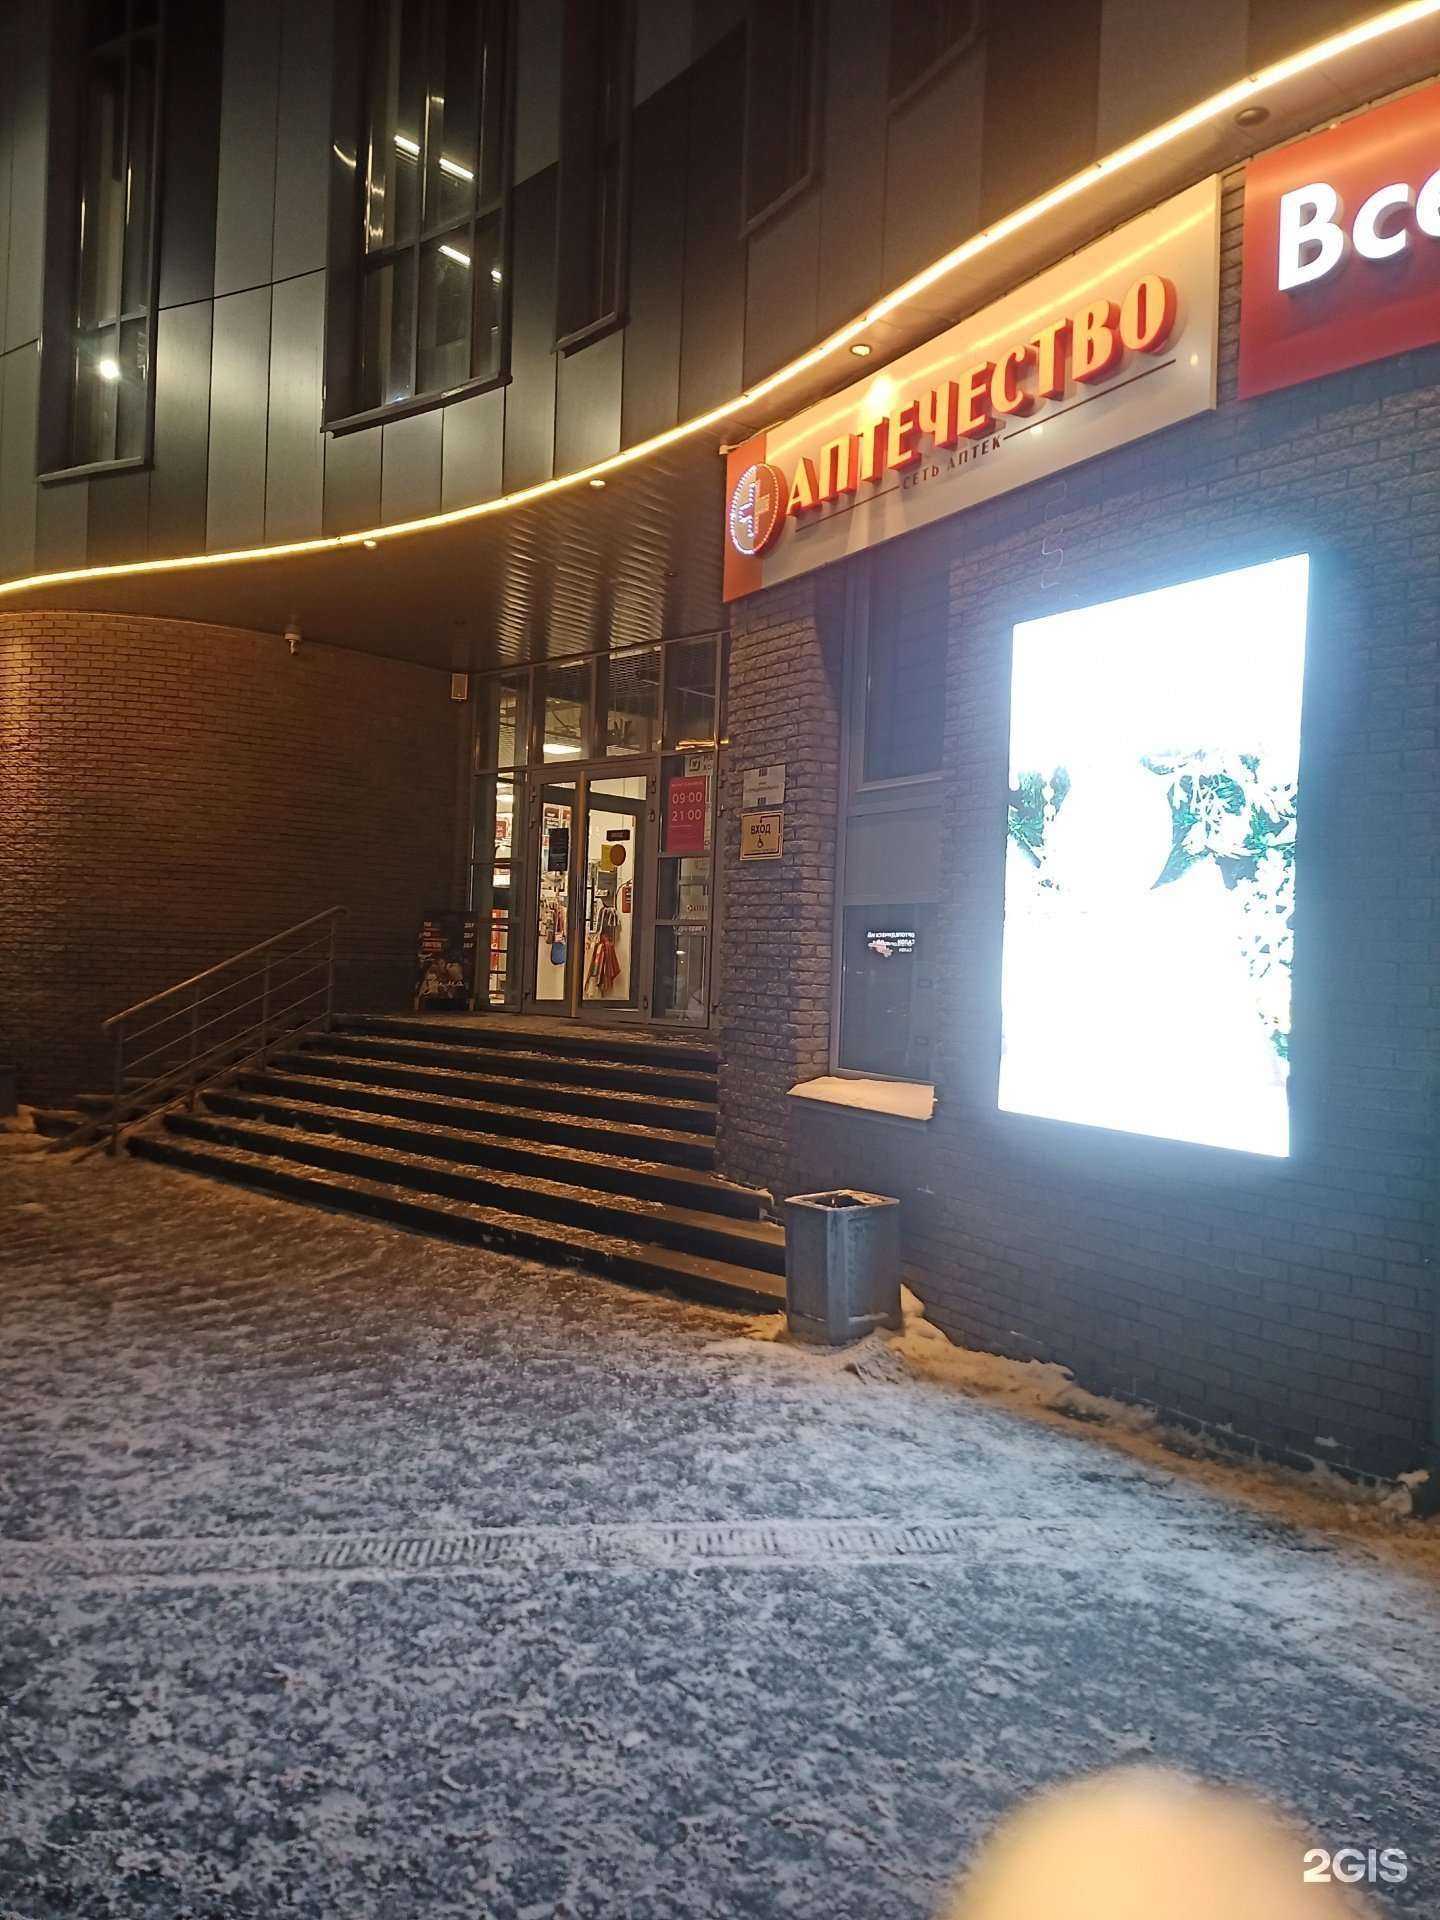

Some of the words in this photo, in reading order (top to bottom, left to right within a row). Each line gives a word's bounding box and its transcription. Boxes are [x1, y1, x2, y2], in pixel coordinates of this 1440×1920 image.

[786, 274, 1178, 518] АПТЕЧЕСТВО
[903, 464, 940, 490] СЕТЬ
[947, 435, 1001, 471] АПТЕК
[751, 824, 771, 835] ВХОД
